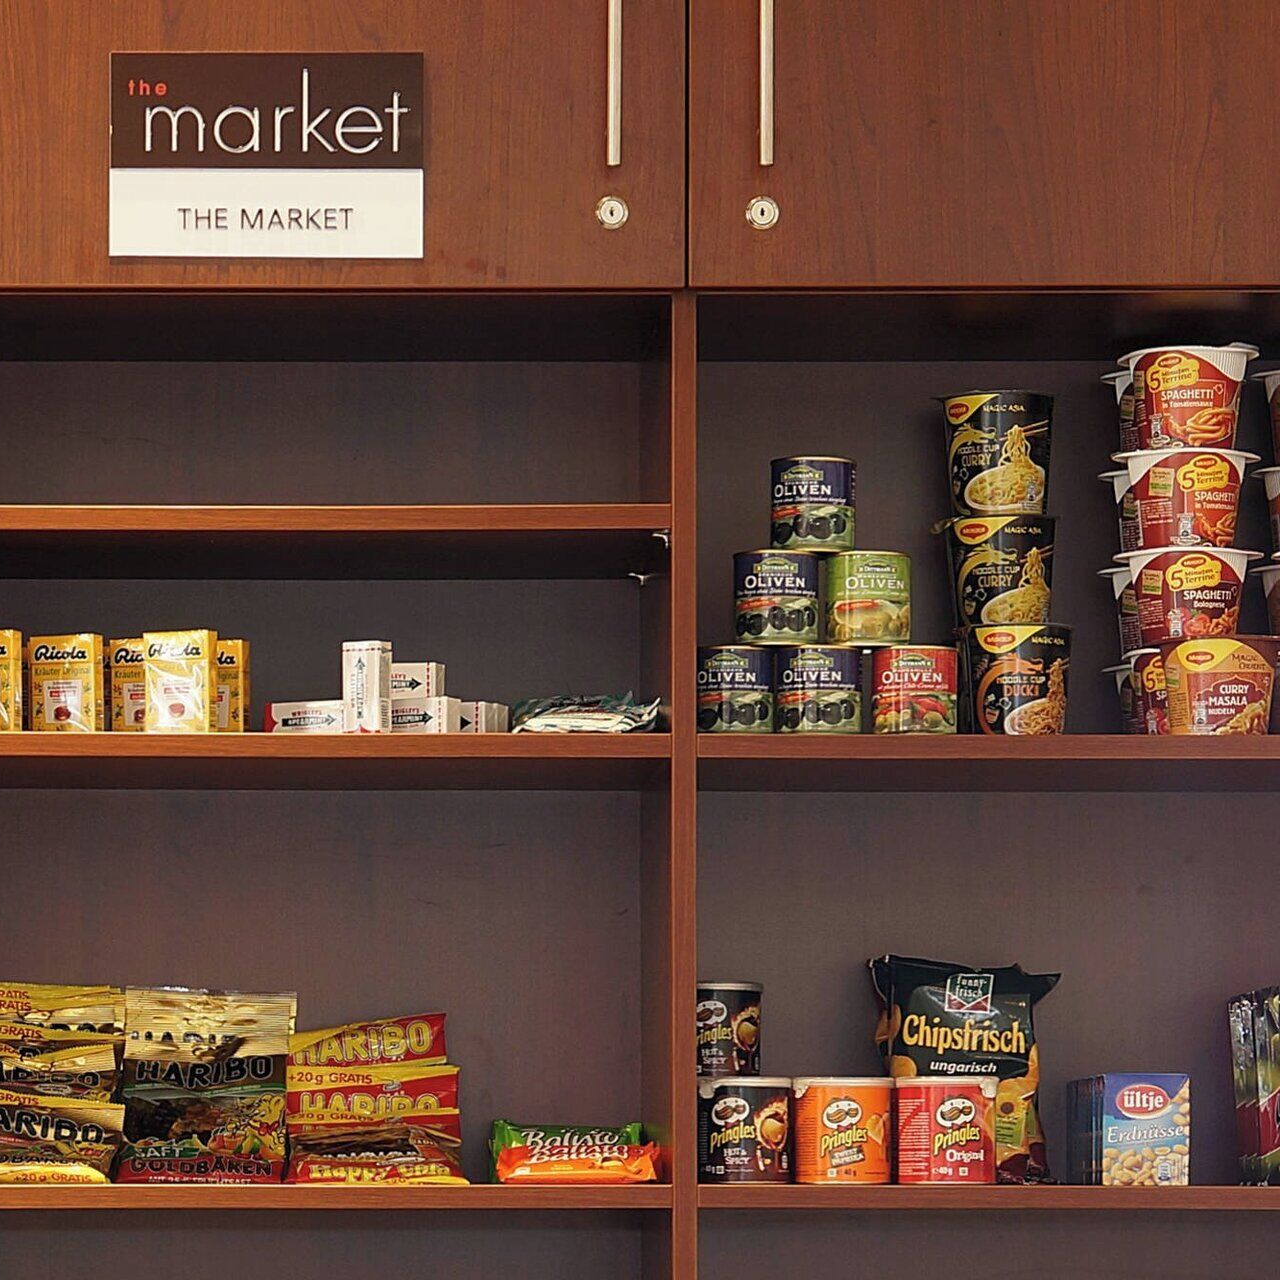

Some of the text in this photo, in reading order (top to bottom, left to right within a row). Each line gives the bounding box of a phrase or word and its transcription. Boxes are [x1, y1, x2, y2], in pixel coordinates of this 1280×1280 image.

[129, 80, 168, 96] the
[144, 69, 410, 153] market
[177, 208, 353, 230] THE MARKET
[1150, 371, 1161, 390] 5
[1161, 389, 1214, 399] SPAGHETTI
[961, 454, 991, 467] CURRY
[1182, 471, 1195, 489] 5
[774, 485, 831, 497] OLIVEN
[745, 575, 805, 588] OLIVEN
[846, 577, 904, 589] OLIVEN
[978, 575, 1013, 587] CURRY
[1171, 570, 1184, 590] 5
[1185, 574, 1215, 584] Terrine
[1183, 590, 1232, 599] SPAGHETTI
[35, 644, 88, 662] Ricola
[34, 667, 61, 677] Kräuter
[697, 671, 756, 683] OLIVEN
[783, 670, 841, 683] OLIVEN
[882, 671, 942, 683] OLIVEN
[1145, 672, 1156, 690] 5
[1219, 685, 1250, 695] CURRY
[1208, 695, 1248, 706] MASALA
[1208, 708, 1236, 716] NUDELN
[955, 984, 983, 997] frisch
[0, 1025, 42, 1038] GRATIS
[902, 1014, 1026, 1054] Chipsfrisch
[293, 1021, 433, 1066] HARIBO
[136, 1055, 273, 1090] HARIBO
[930, 1061, 997, 1074] ungarisch
[289, 1073, 373, 1084] +20 GRATIS
[1123, 1090, 1164, 1110] ültje
[521, 1128, 620, 1147] Balisto
[710, 1124, 756, 1154] Pringles
[1107, 1125, 1184, 1143] Erdnüsse
[820, 1128, 869, 1157] Pringles
[933, 1126, 981, 1157] Pringles
[135, 1146, 184, 1158] SAFT
[524, 1145, 629, 1165] Balisto
[945, 1149, 984, 1163] Original
[130, 1159, 273, 1176] GOLDBÄREN
